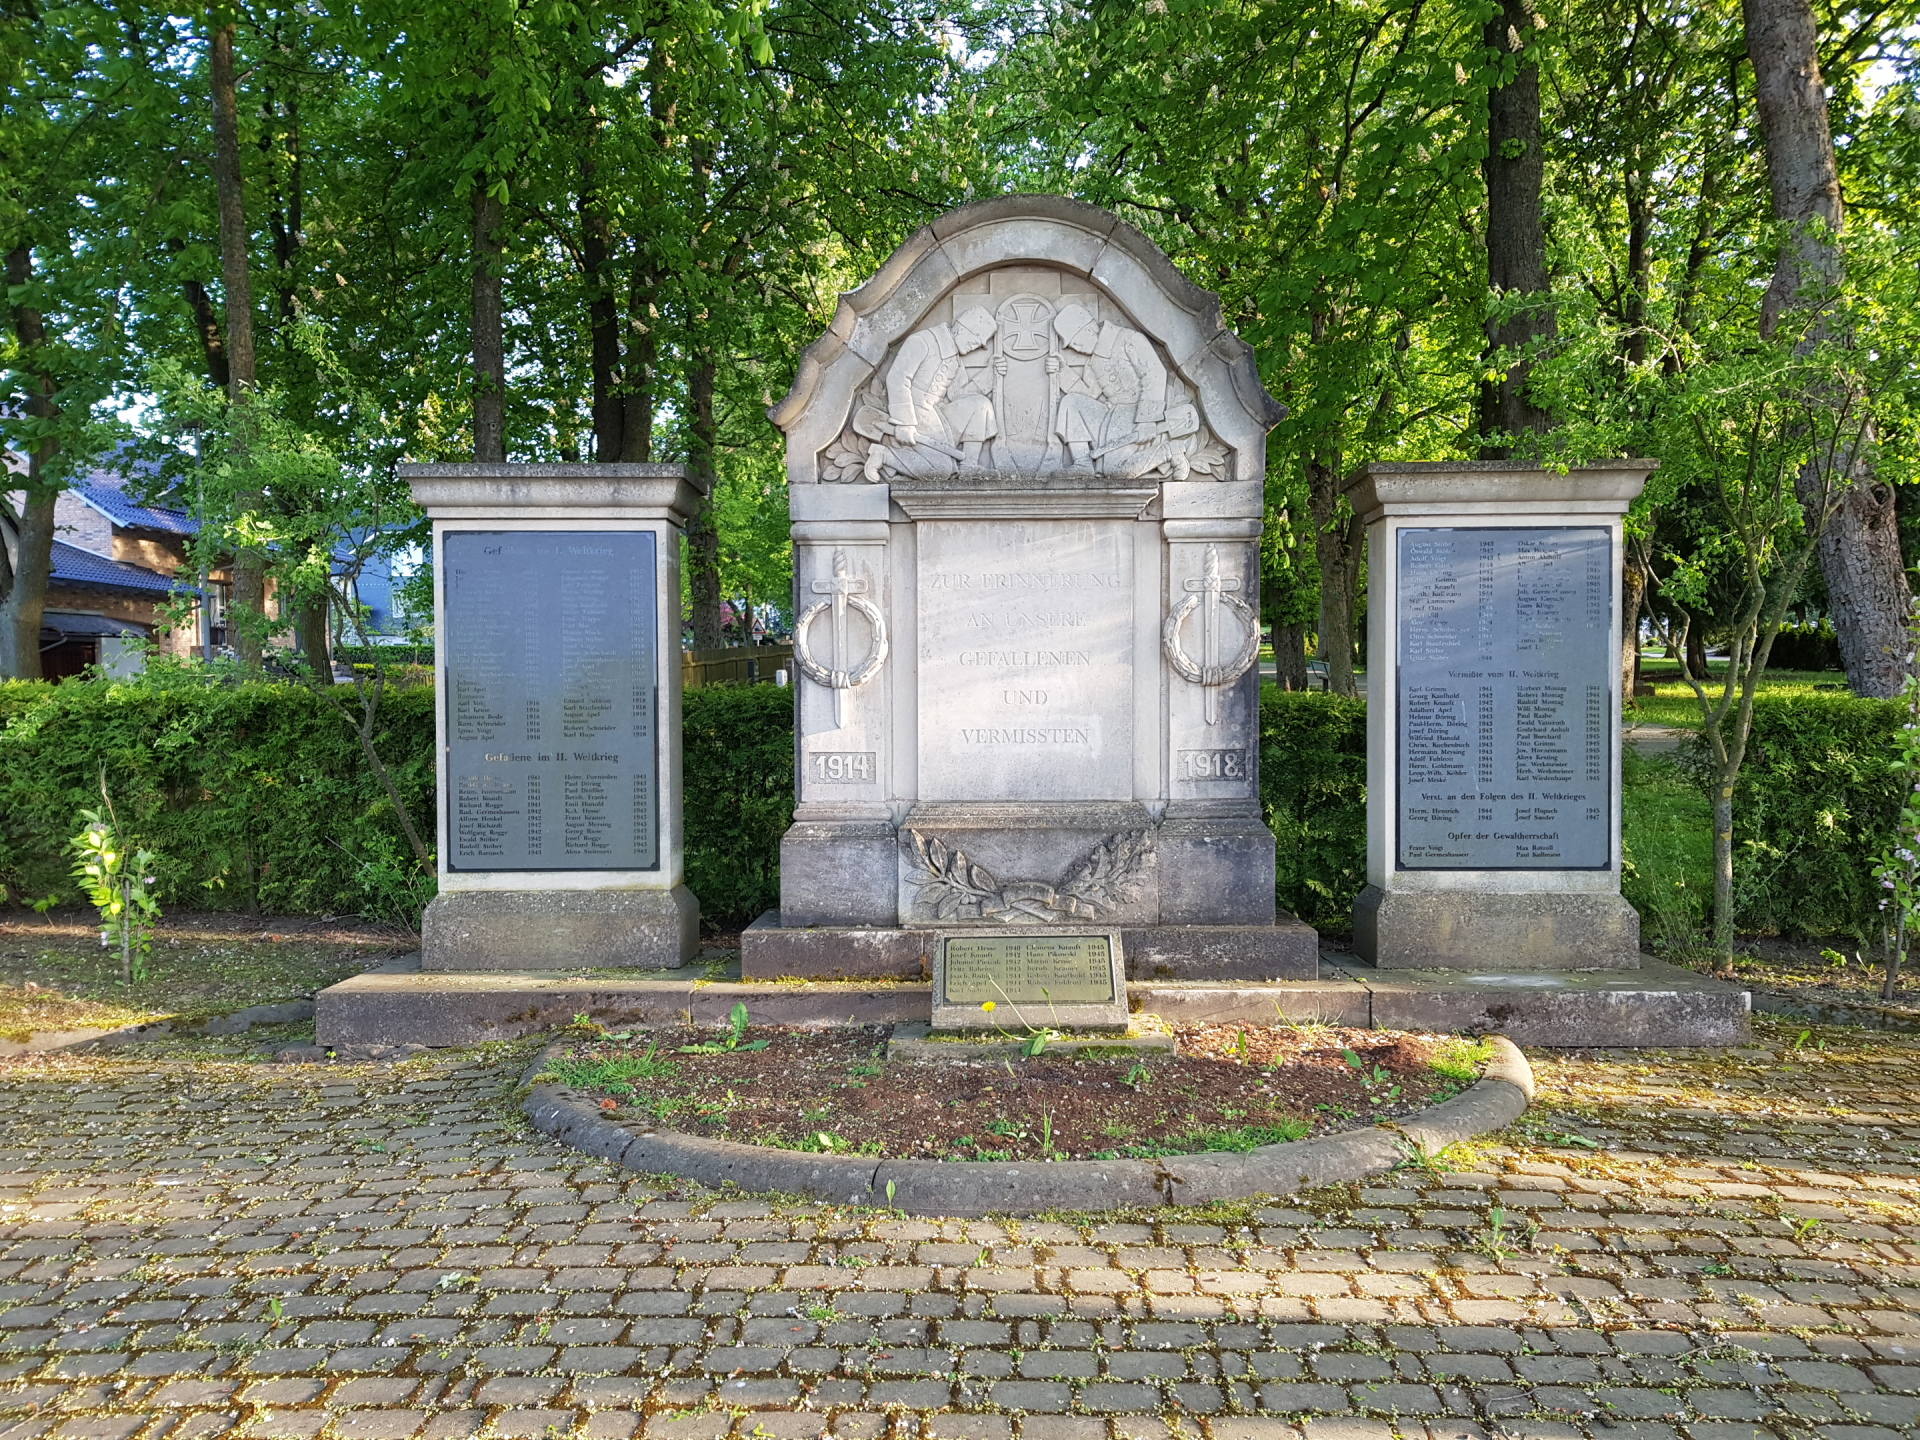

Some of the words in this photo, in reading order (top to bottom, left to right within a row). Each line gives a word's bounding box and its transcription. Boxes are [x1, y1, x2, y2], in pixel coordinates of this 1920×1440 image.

[930, 573, 971, 591] ZUR
[981, 573, 1122, 591] ERINNERUNG
[966, 612, 994, 628] AN
[1004, 612, 1086, 628] UNSERE
[958, 651, 1091, 667] GEFALLENEN
[1448, 670, 1483, 679] Vermißte
[1509, 670, 1518, 678] II.
[1002, 690, 1049, 705] UND
[961, 728, 1089, 744] VERMISSTEN
[537, 753, 550, 761] im
[556, 752, 567, 761] II.
[1184, 753, 1241, 776] 1918
[816, 755, 868, 779] 1914
[1480, 793, 1506, 802] Folgen
[1542, 792, 1586, 802] Weltkrieges
[1447, 832, 1471, 842] Opfer
[1493, 832, 1560, 840] Gewaltherrschaft
